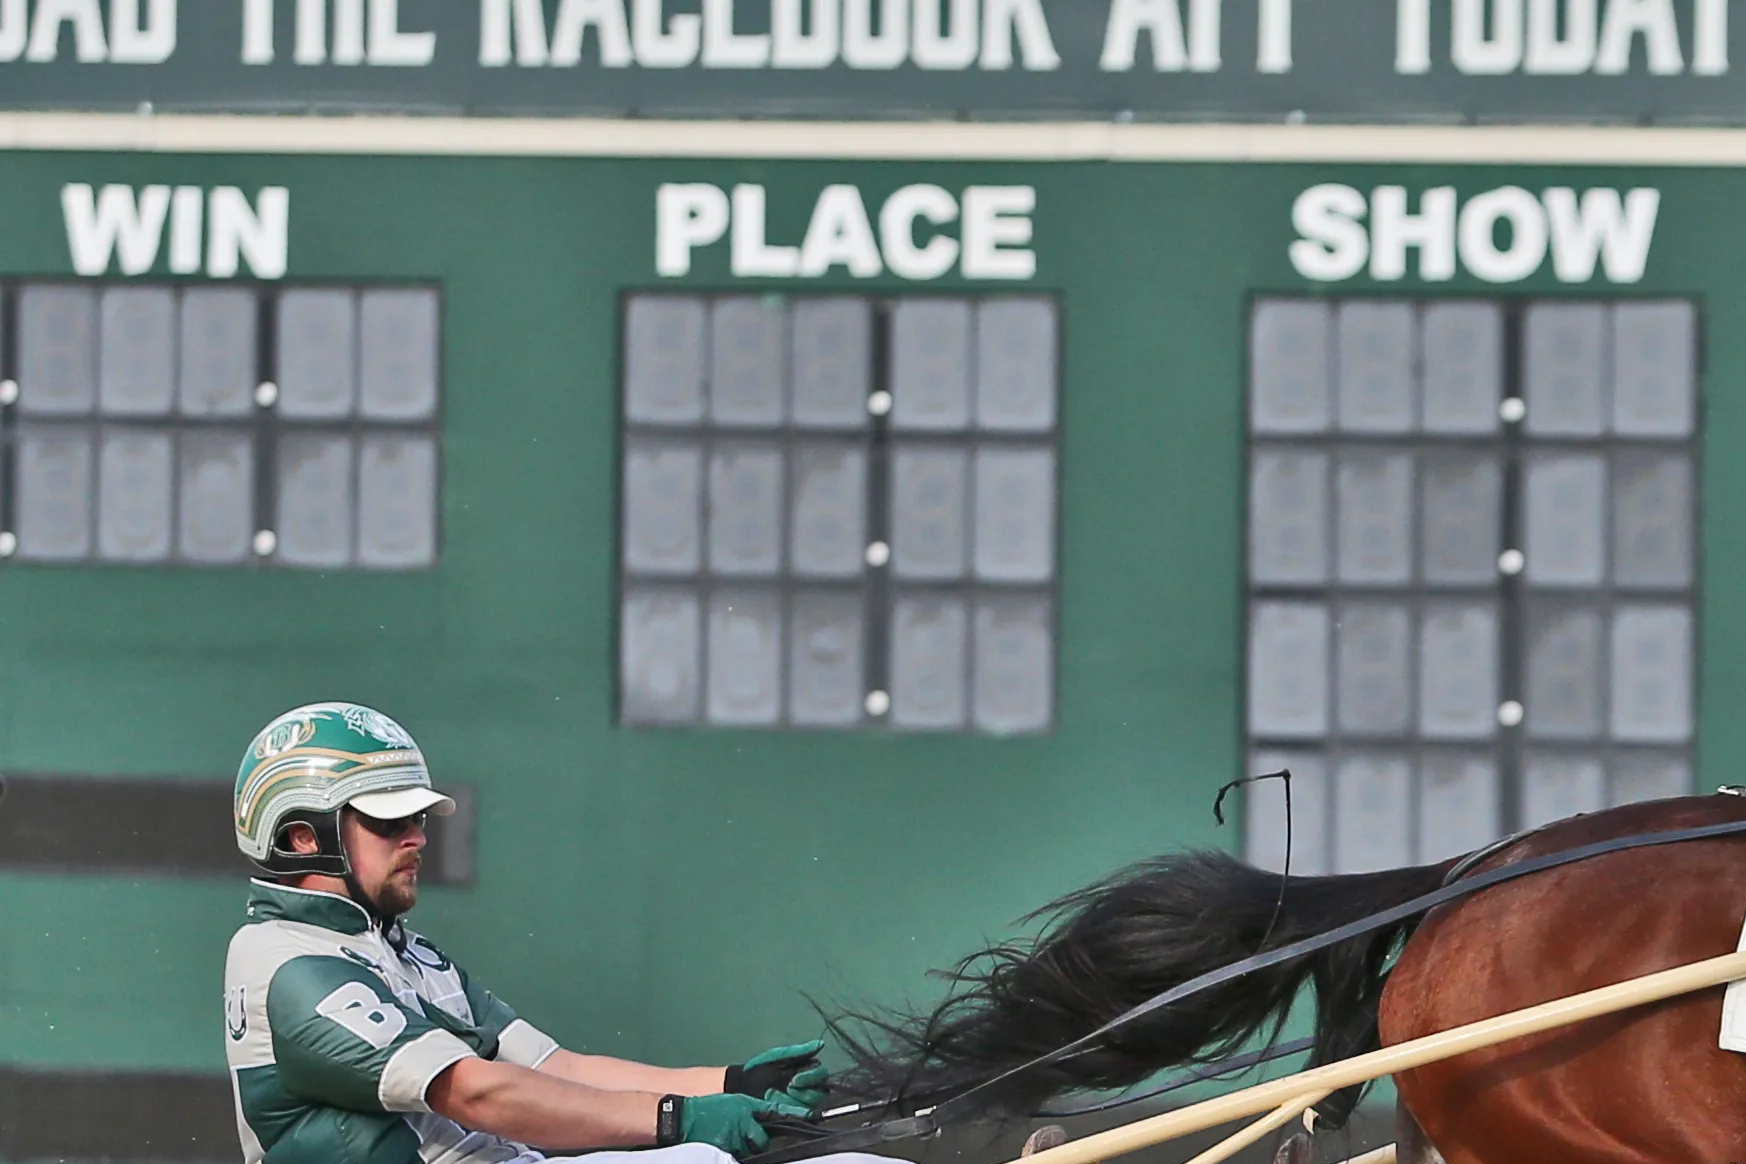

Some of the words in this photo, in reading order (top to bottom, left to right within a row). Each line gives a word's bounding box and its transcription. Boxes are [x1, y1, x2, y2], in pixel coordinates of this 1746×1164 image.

[61, 182, 290, 279] WIN
[655, 182, 1036, 280] PLACE
[1289, 183, 1660, 283] SHOW
[315, 981, 407, 1049] B
